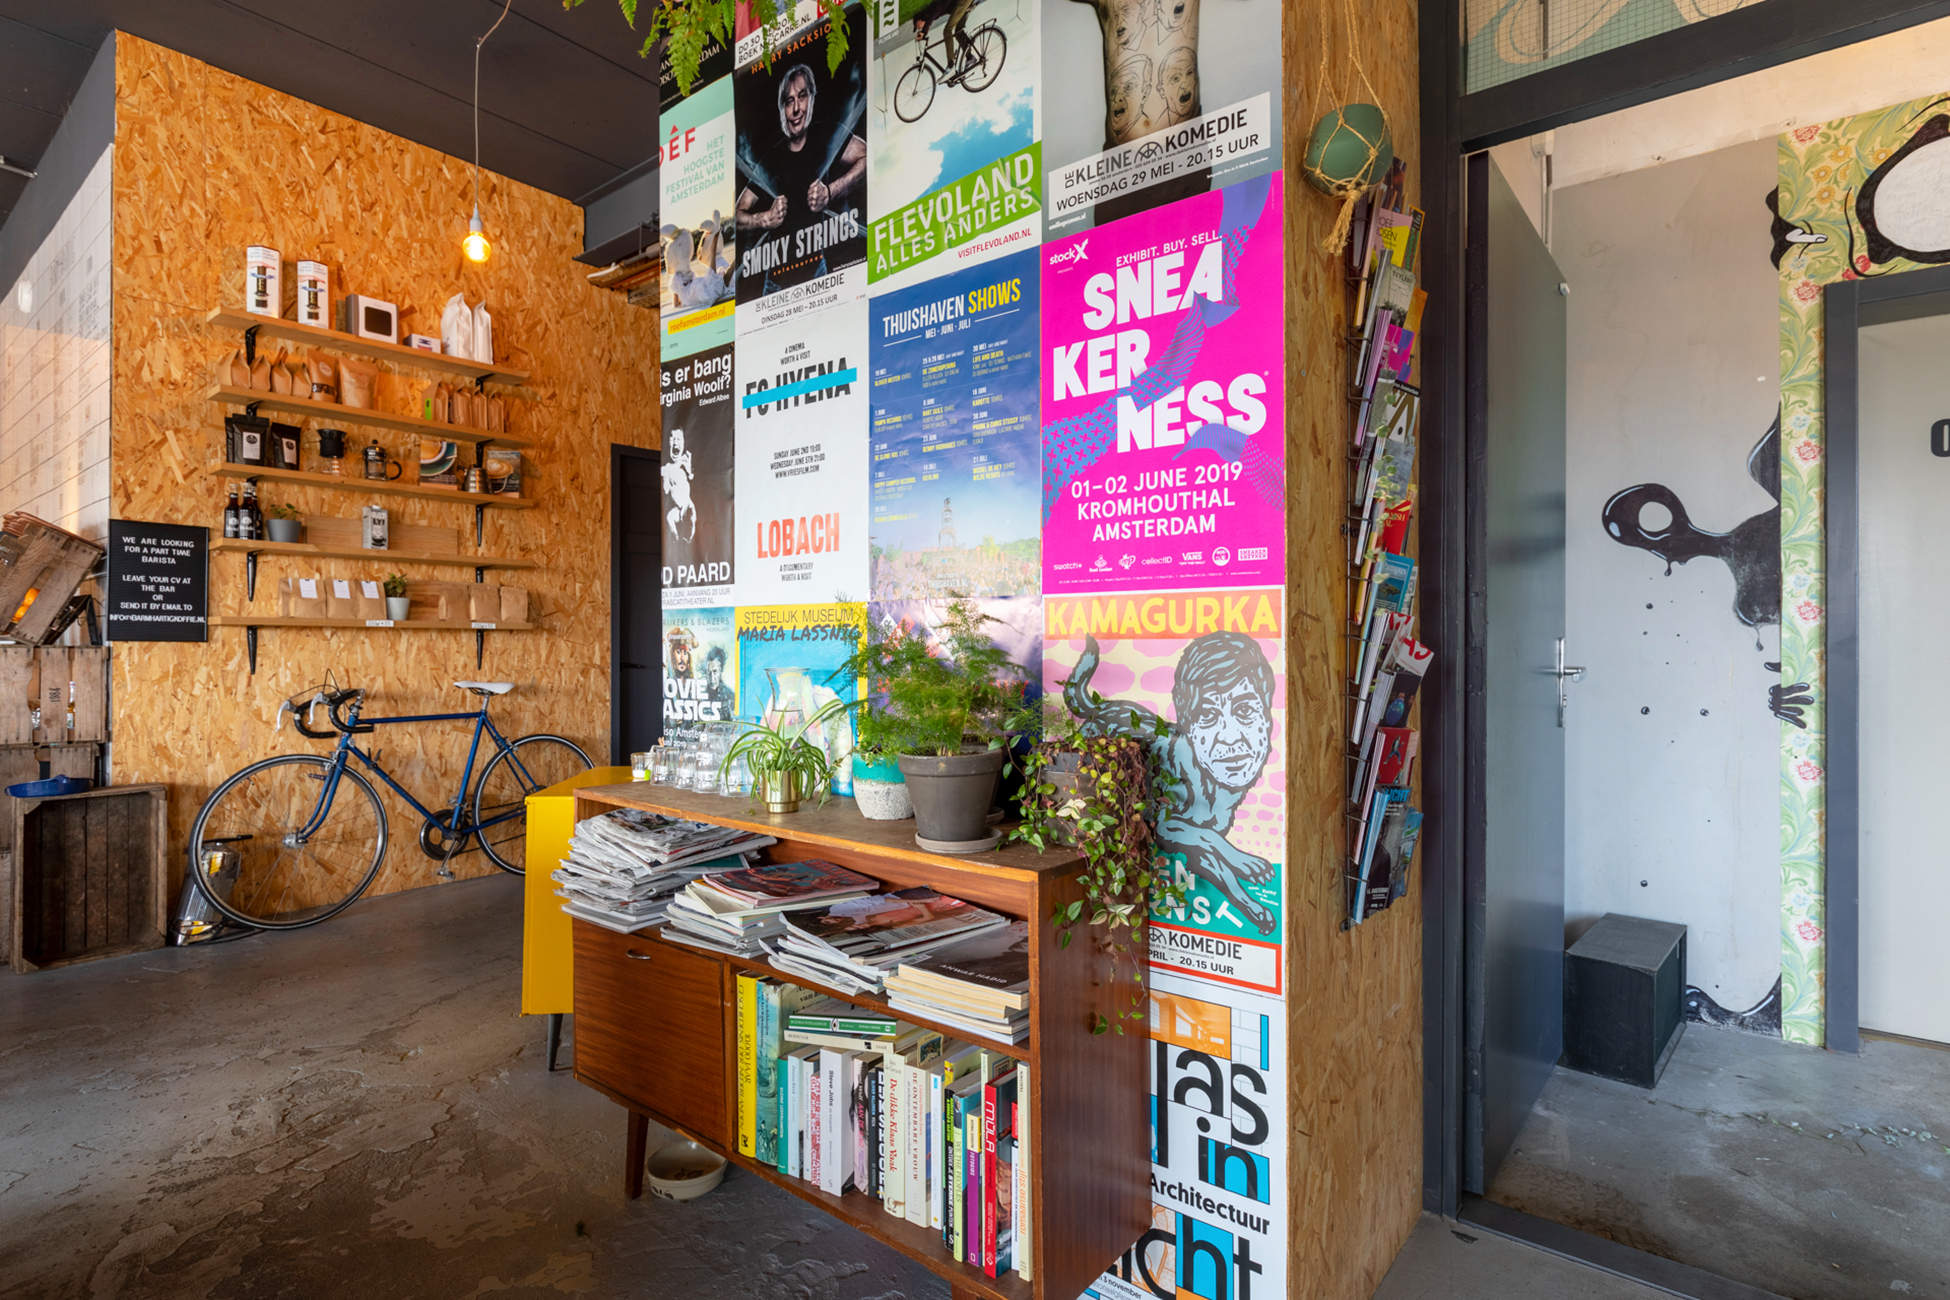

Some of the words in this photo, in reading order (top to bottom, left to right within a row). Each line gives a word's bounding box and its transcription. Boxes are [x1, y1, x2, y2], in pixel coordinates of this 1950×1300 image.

[738, 47, 758, 63] BOEK
[751, 49, 782, 75] HARY
[707, 135, 725, 151] HET
[1075, 149, 1132, 184] KLEINE
[1165, 108, 1248, 153] KOMEDIE
[683, 147, 725, 175] HOOGSTE
[1056, 177, 1128, 211] WOENSDAG
[1131, 171, 1146, 186] 29
[1150, 161, 1175, 180] MEI
[1186, 144, 1223, 168] 20.15
[1228, 134, 1259, 153] UUR
[666, 170, 704, 195] FESTIVAL
[706, 160, 725, 176] VAN
[670, 172, 725, 205] AMSTERDAM
[874, 153, 1034, 253] FLEVOLAND
[876, 231, 935, 274] ALLES
[944, 186, 1033, 244] ANDERS
[742, 235, 790, 279] SMOKY
[795, 208, 859, 258] STRINGS
[957, 228, 1032, 259] VISITFLEVOLAND.NL
[1116, 246, 1160, 267] EXHIBIT.
[1163, 238, 1187, 255] BUY.
[1191, 230, 1222, 249] SELL.
[761, 291, 790, 311] KLEINE
[805, 273, 845, 296] KOMEDIE
[1083, 240, 1223, 331] SNEA
[669, 306, 726, 333] roefamsterdam.nl
[761, 311, 785, 324] DINSDAG
[785, 309, 792, 317] 28
[793, 305, 804, 314] MEI
[808, 298, 824, 310] 20.15
[825, 294, 838, 305] UUR
[883, 294, 965, 338] THUISHAVEN
[968, 278, 1021, 314] SHOWS
[925, 328, 936, 339] MEI
[940, 323, 954, 336] JUNI
[958, 318, 971, 331] JULI
[674, 363, 691, 383] er
[693, 353, 732, 379] bang
[780, 355, 795, 365] WORTH
[799, 350, 811, 360] VISIT
[1053, 329, 1151, 402] KER
[693, 374, 732, 396] Woolf?
[746, 378, 769, 419] FC
[776, 357, 851, 412] HYENA
[699, 396, 716, 407] Edward
[717, 393, 730, 405] Albee
[1116, 373, 1267, 454] NESS
[770, 459, 793, 470] WEDNESDAY
[794, 457, 805, 466] JUNE
[774, 450, 789, 460] SUNDAY
[790, 448, 800, 456] JUNE
[1134, 468, 1187, 491] JUNE
[1194, 461, 1243, 484] 2019
[1077, 487, 1236, 520] KROMHOUTHAL
[757, 512, 840, 559] LOBACH
[1092, 514, 1216, 542] AMSTERDAM
[122, 536, 136, 544] WE
[161, 539, 194, 548] LOOKING
[151, 547, 169, 555] PART
[172, 549, 191, 557] TIME
[142, 556, 176, 564] BARISTA
[783, 562, 814, 572] DOCUMENTARY
[1182, 552, 1203, 561] VANS
[122, 574, 146, 582] LEAVE
[677, 561, 731, 584] PAARD
[781, 573, 796, 581] WORTH
[801, 572, 812, 580] VISIT
[687, 589, 710, 597] AANVANG
[162, 603, 182, 611] EMAIL
[744, 610, 798, 624] STEDELIJK
[802, 608, 854, 623] MUSEUM
[1048, 594, 1278, 636] KAMAGURKA
[698, 617, 730, 626] BLAZERS
[737, 625, 785, 642] MARIA
[791, 624, 863, 642] LASSNIG
[663, 677, 709, 700] OVIE
[676, 727, 701, 739] Amster
[1169, 931, 1242, 960] KOMEDIE
[1180, 956, 1207, 969] 20.15
[1211, 962, 1234, 975] UUR
[890, 1078, 898, 1092] De
[912, 1072, 918, 1084] DE
[890, 1093, 898, 1120] dikke
[890, 1121, 898, 1147] Klaas
[890, 1149, 898, 1172] Vaak
[1196, 1116, 1258, 1201] in
[1019, 1169, 1028, 1189] stijl
[1150, 1172, 1270, 1236] Architectuur
[1108, 1278, 1142, 1300] november
